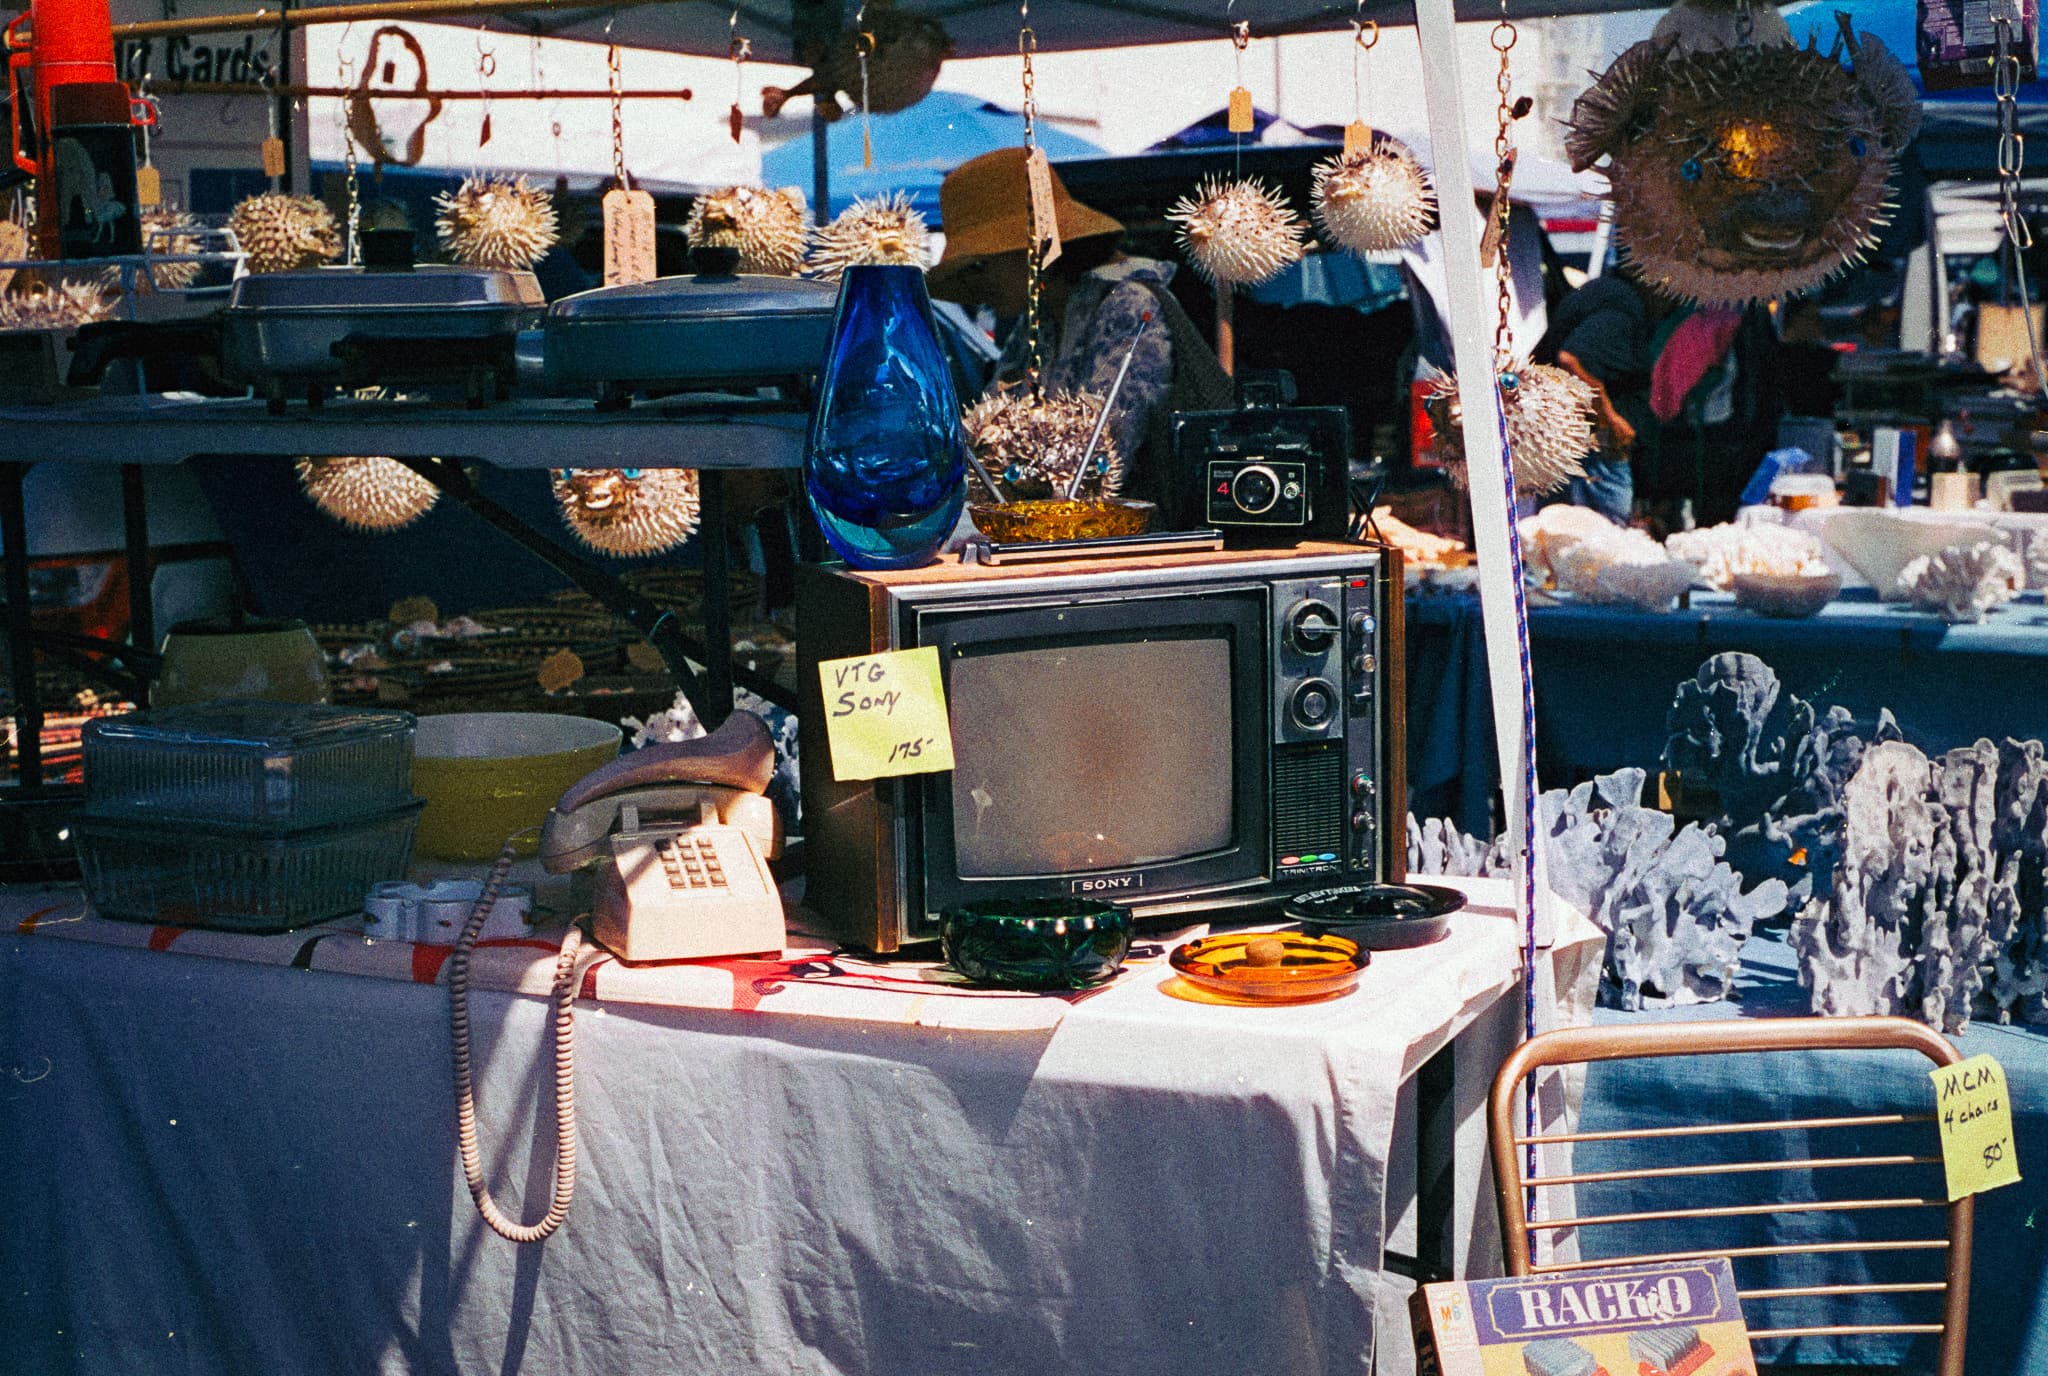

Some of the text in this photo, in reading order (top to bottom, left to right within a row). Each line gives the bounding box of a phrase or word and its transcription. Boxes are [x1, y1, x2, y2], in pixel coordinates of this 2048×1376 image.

[1216, 482, 1230, 496] 4
[835, 662, 885, 689] VTG
[1282, 864, 1337, 877] TRINITRON
[1082, 877, 1132, 891] SONY
[1943, 1066, 1996, 1101] MCM
[1944, 1099, 1999, 1134] 4 chairs
